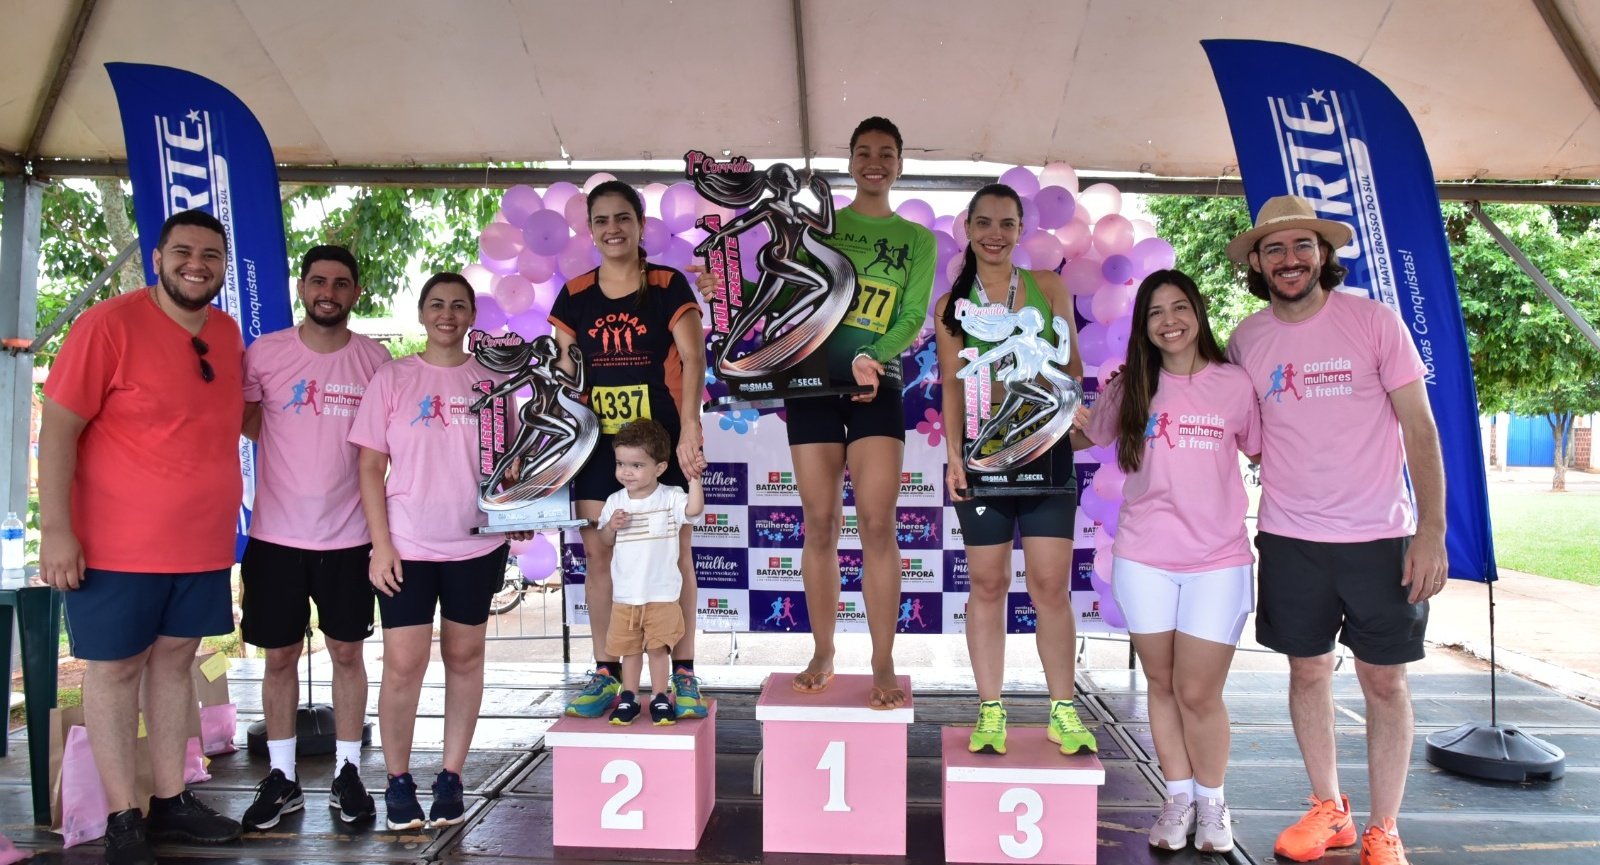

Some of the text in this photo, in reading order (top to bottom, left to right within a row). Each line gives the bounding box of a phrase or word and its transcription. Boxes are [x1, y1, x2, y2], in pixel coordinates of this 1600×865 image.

[702, 158, 753, 174] Corrida
[220, 189, 228, 206] SUL
[222, 210, 230, 223] DO
[1361, 174, 1395, 305] DE MATO GROSSO DO SUL
[227, 264, 235, 292] MATO
[724, 235, 743, 307] FRENTE
[231, 296, 237, 308] DE
[243, 258, 262, 338] Conquistas!
[587, 312, 647, 338] ACONAR
[1397, 249, 1437, 386] Novas Conquistas!
[480, 332, 522, 348] Corrida
[1303, 357, 1352, 373] corrida
[797, 378, 823, 386] SECEL
[1304, 373, 1351, 385] mulheres
[1305, 384, 1353, 398] à frente
[324, 395, 361, 406] mulhere
[594, 390, 643, 419] 1337
[493, 396, 505, 453] FRENTE
[1180, 413, 1225, 427] corrida
[1179, 425, 1223, 439] mulheres
[481, 407, 493, 475] MULHERES
[1178, 436, 1220, 451] à frene
[242, 437, 251, 477] FUNDAÇ
[755, 520, 794, 529] mulheres
[695, 555, 739, 570] mulher
[1014, 607, 1037, 615] mulh
[816, 741, 852, 812] 1
[600, 759, 644, 830] 2
[998, 787, 1044, 859] 3
